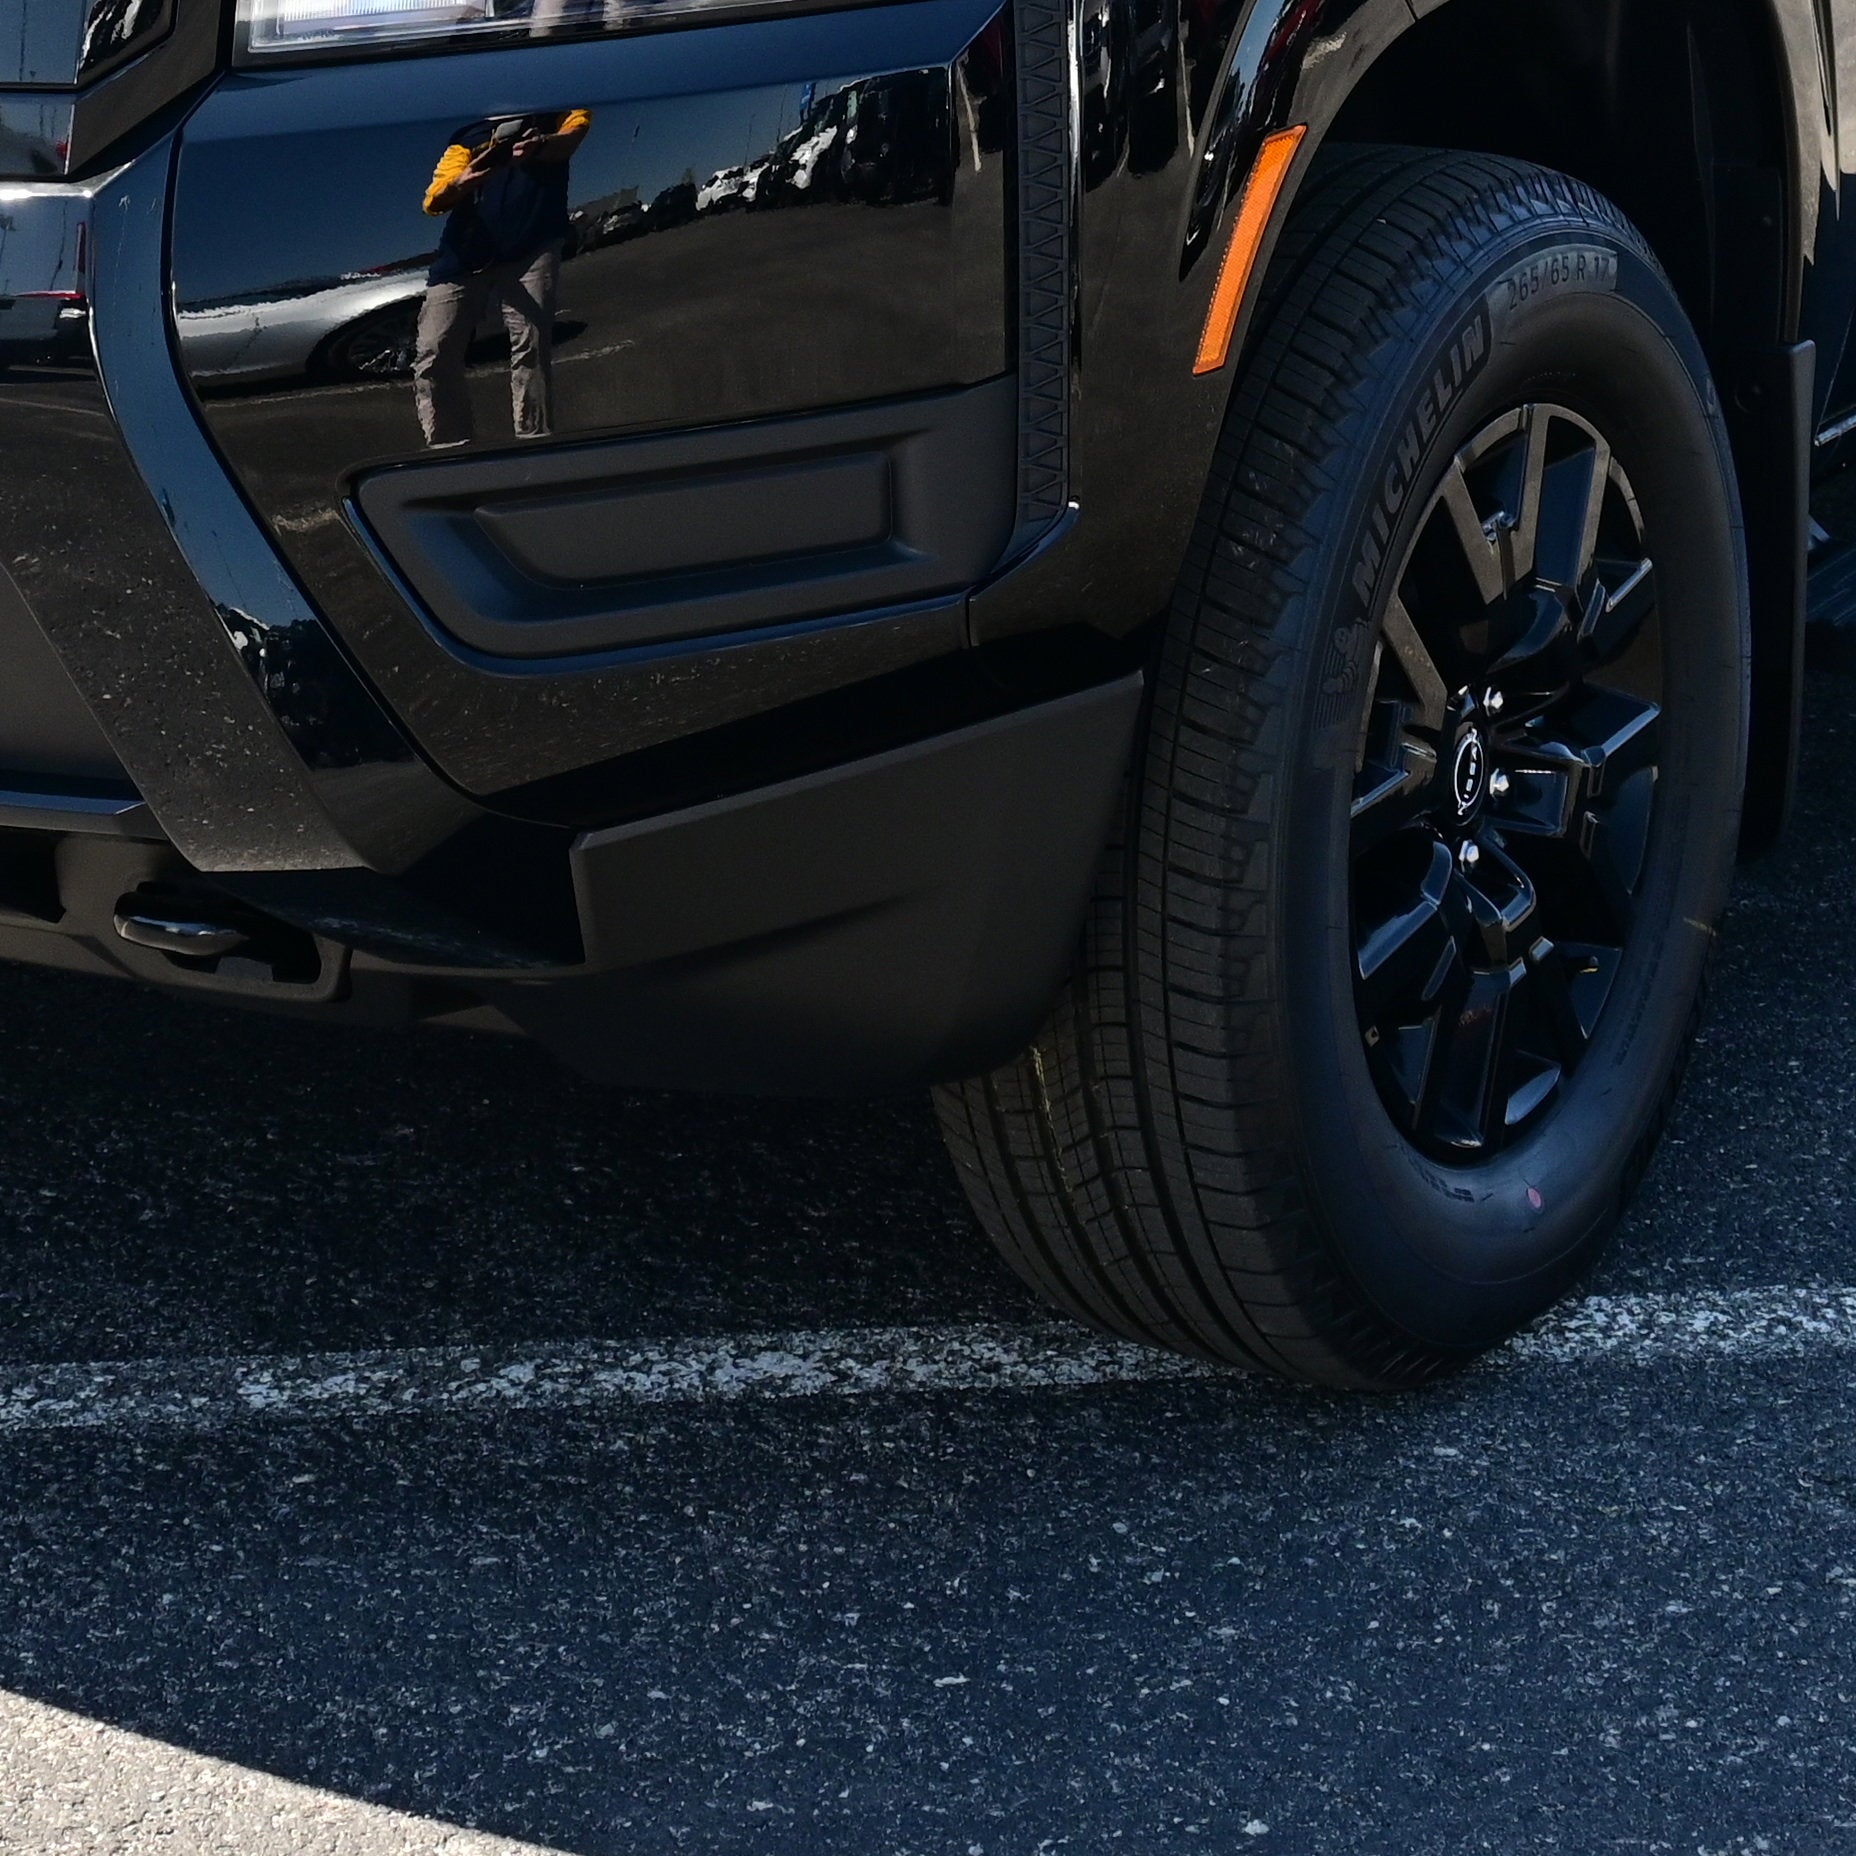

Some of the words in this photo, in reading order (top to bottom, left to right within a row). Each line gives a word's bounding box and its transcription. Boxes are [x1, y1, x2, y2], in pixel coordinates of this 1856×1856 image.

[1508, 254, 1571, 312] 265/65
[1576, 254, 1587, 281] R
[1593, 256, 1611, 282] 17
[1352, 313, 1487, 608] MICHELIN
